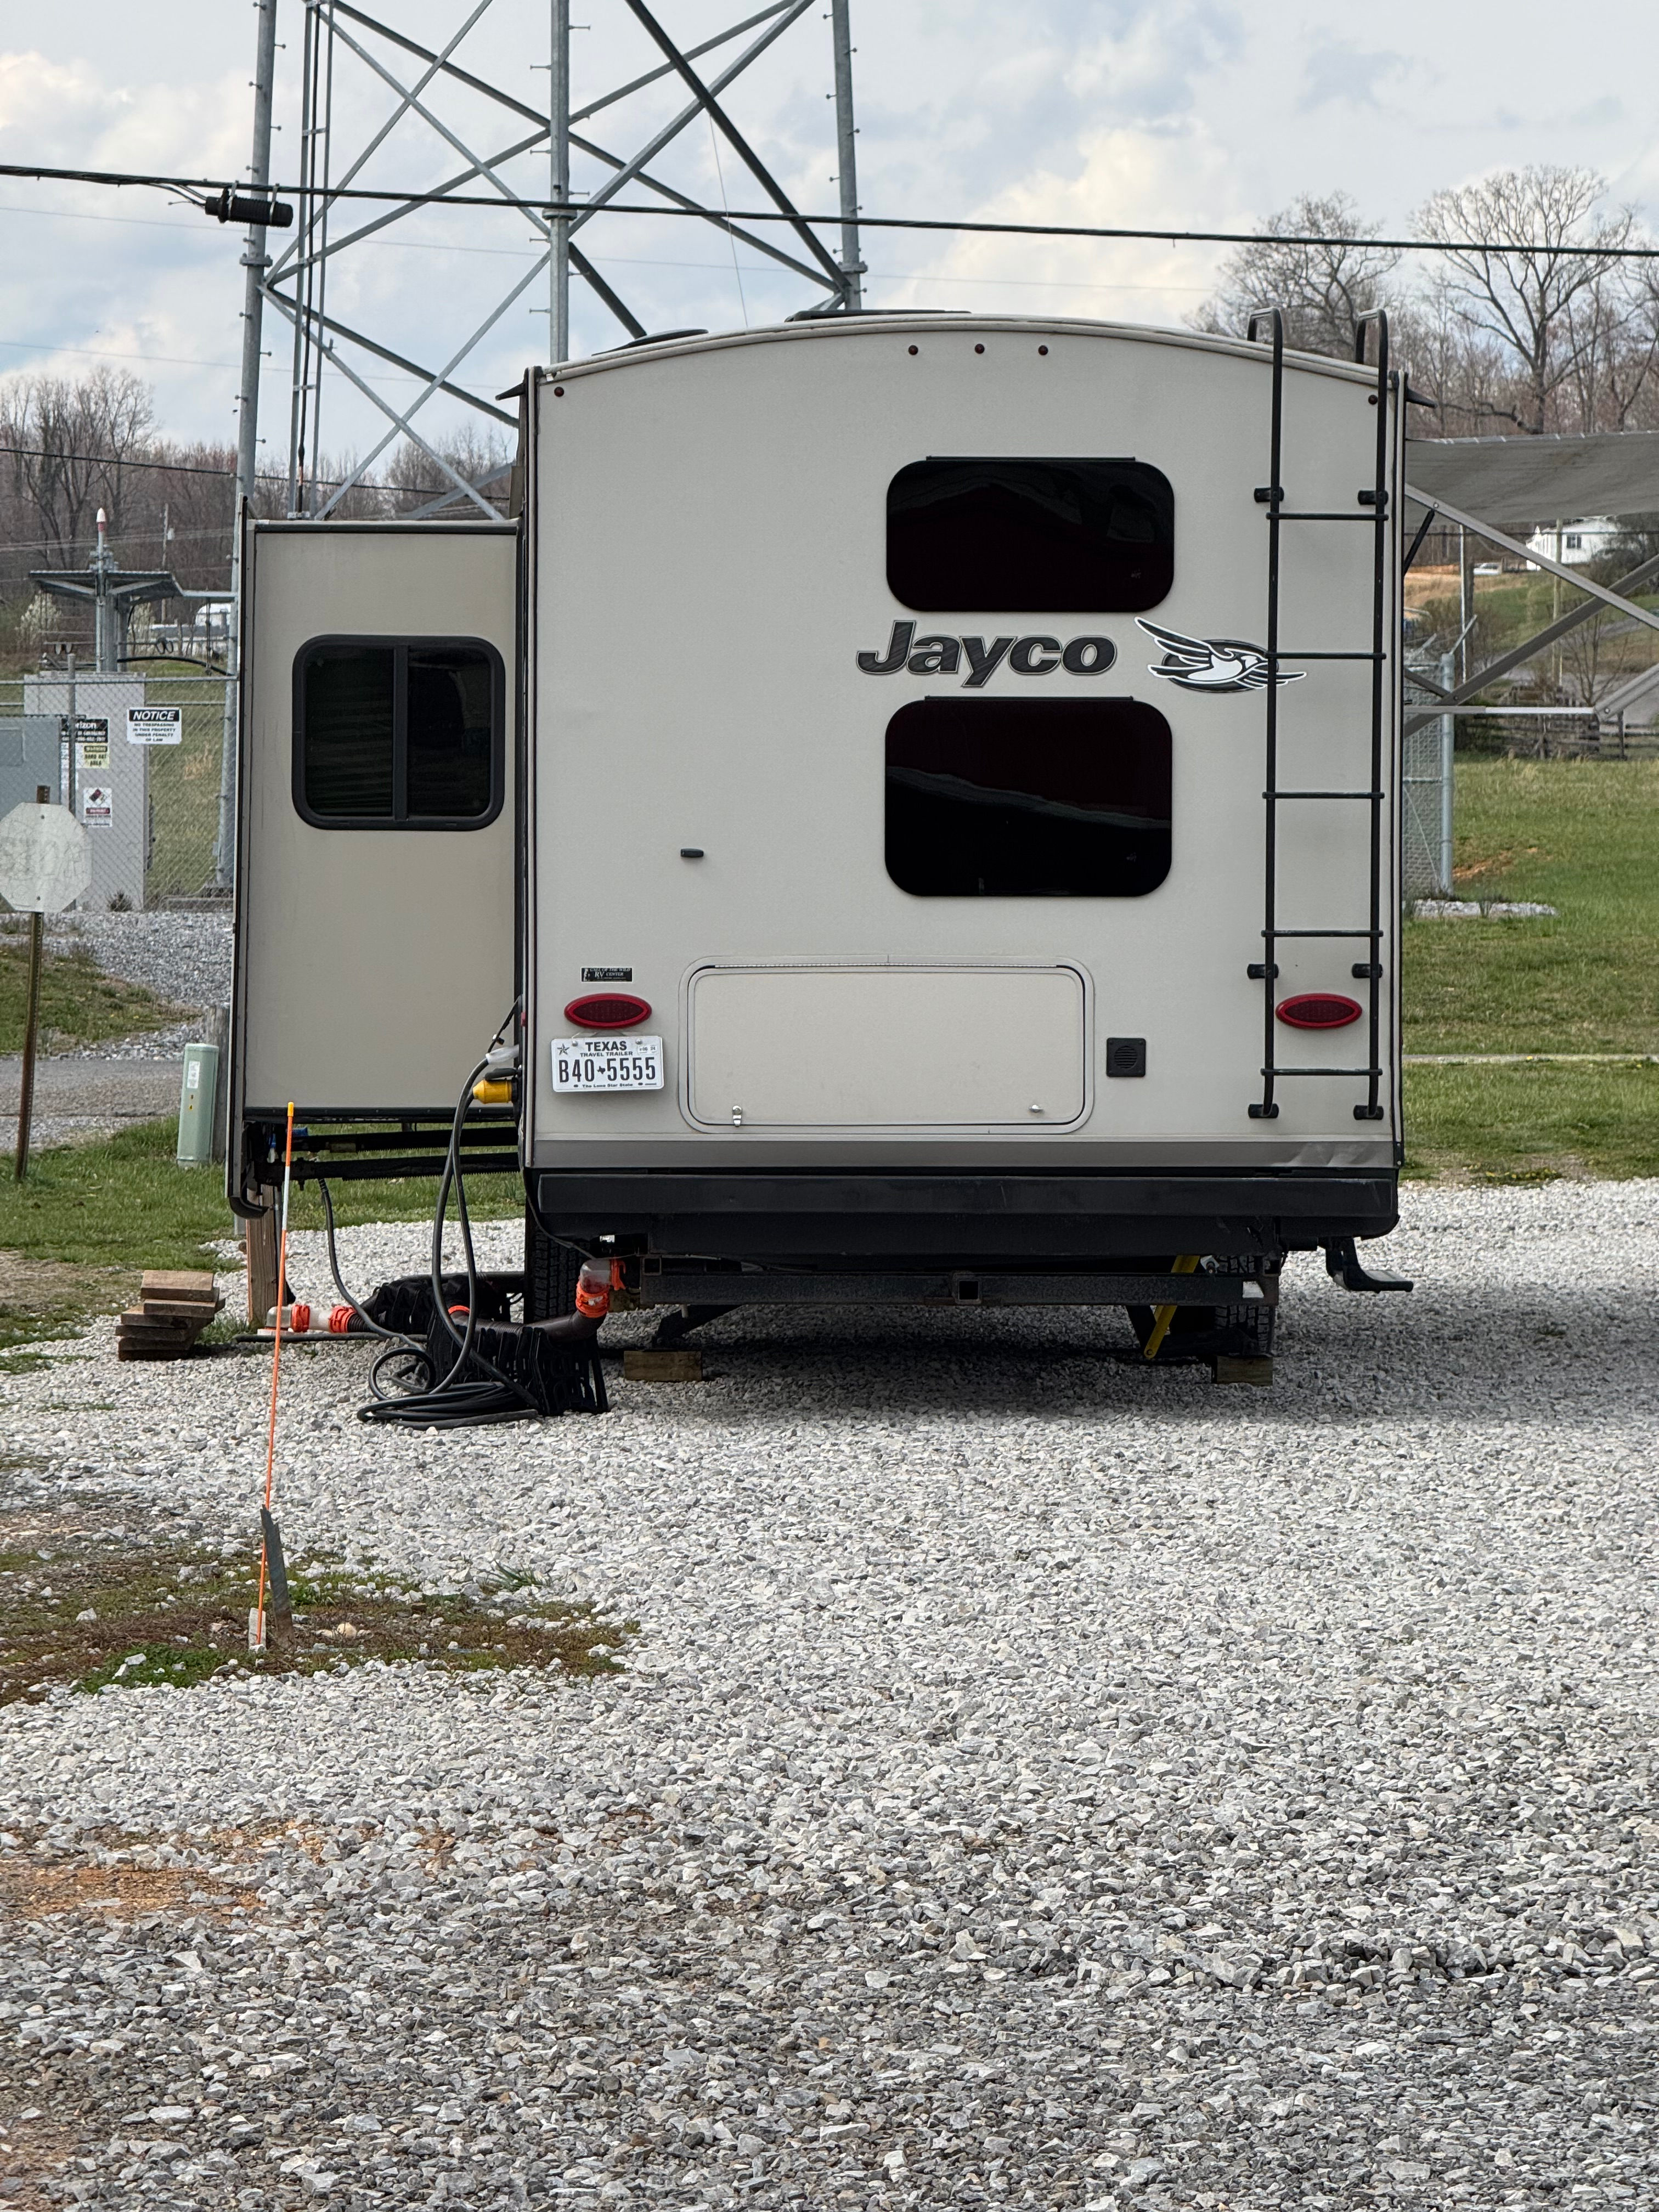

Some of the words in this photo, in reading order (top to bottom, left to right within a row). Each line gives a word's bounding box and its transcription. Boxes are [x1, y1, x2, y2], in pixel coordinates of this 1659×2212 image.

[856, 619, 1117, 688] Jayco
[133, 711, 176, 720] NOTICE
[585, 1041, 627, 1052] TEXAS
[607, 1057, 656, 1081] 5555
